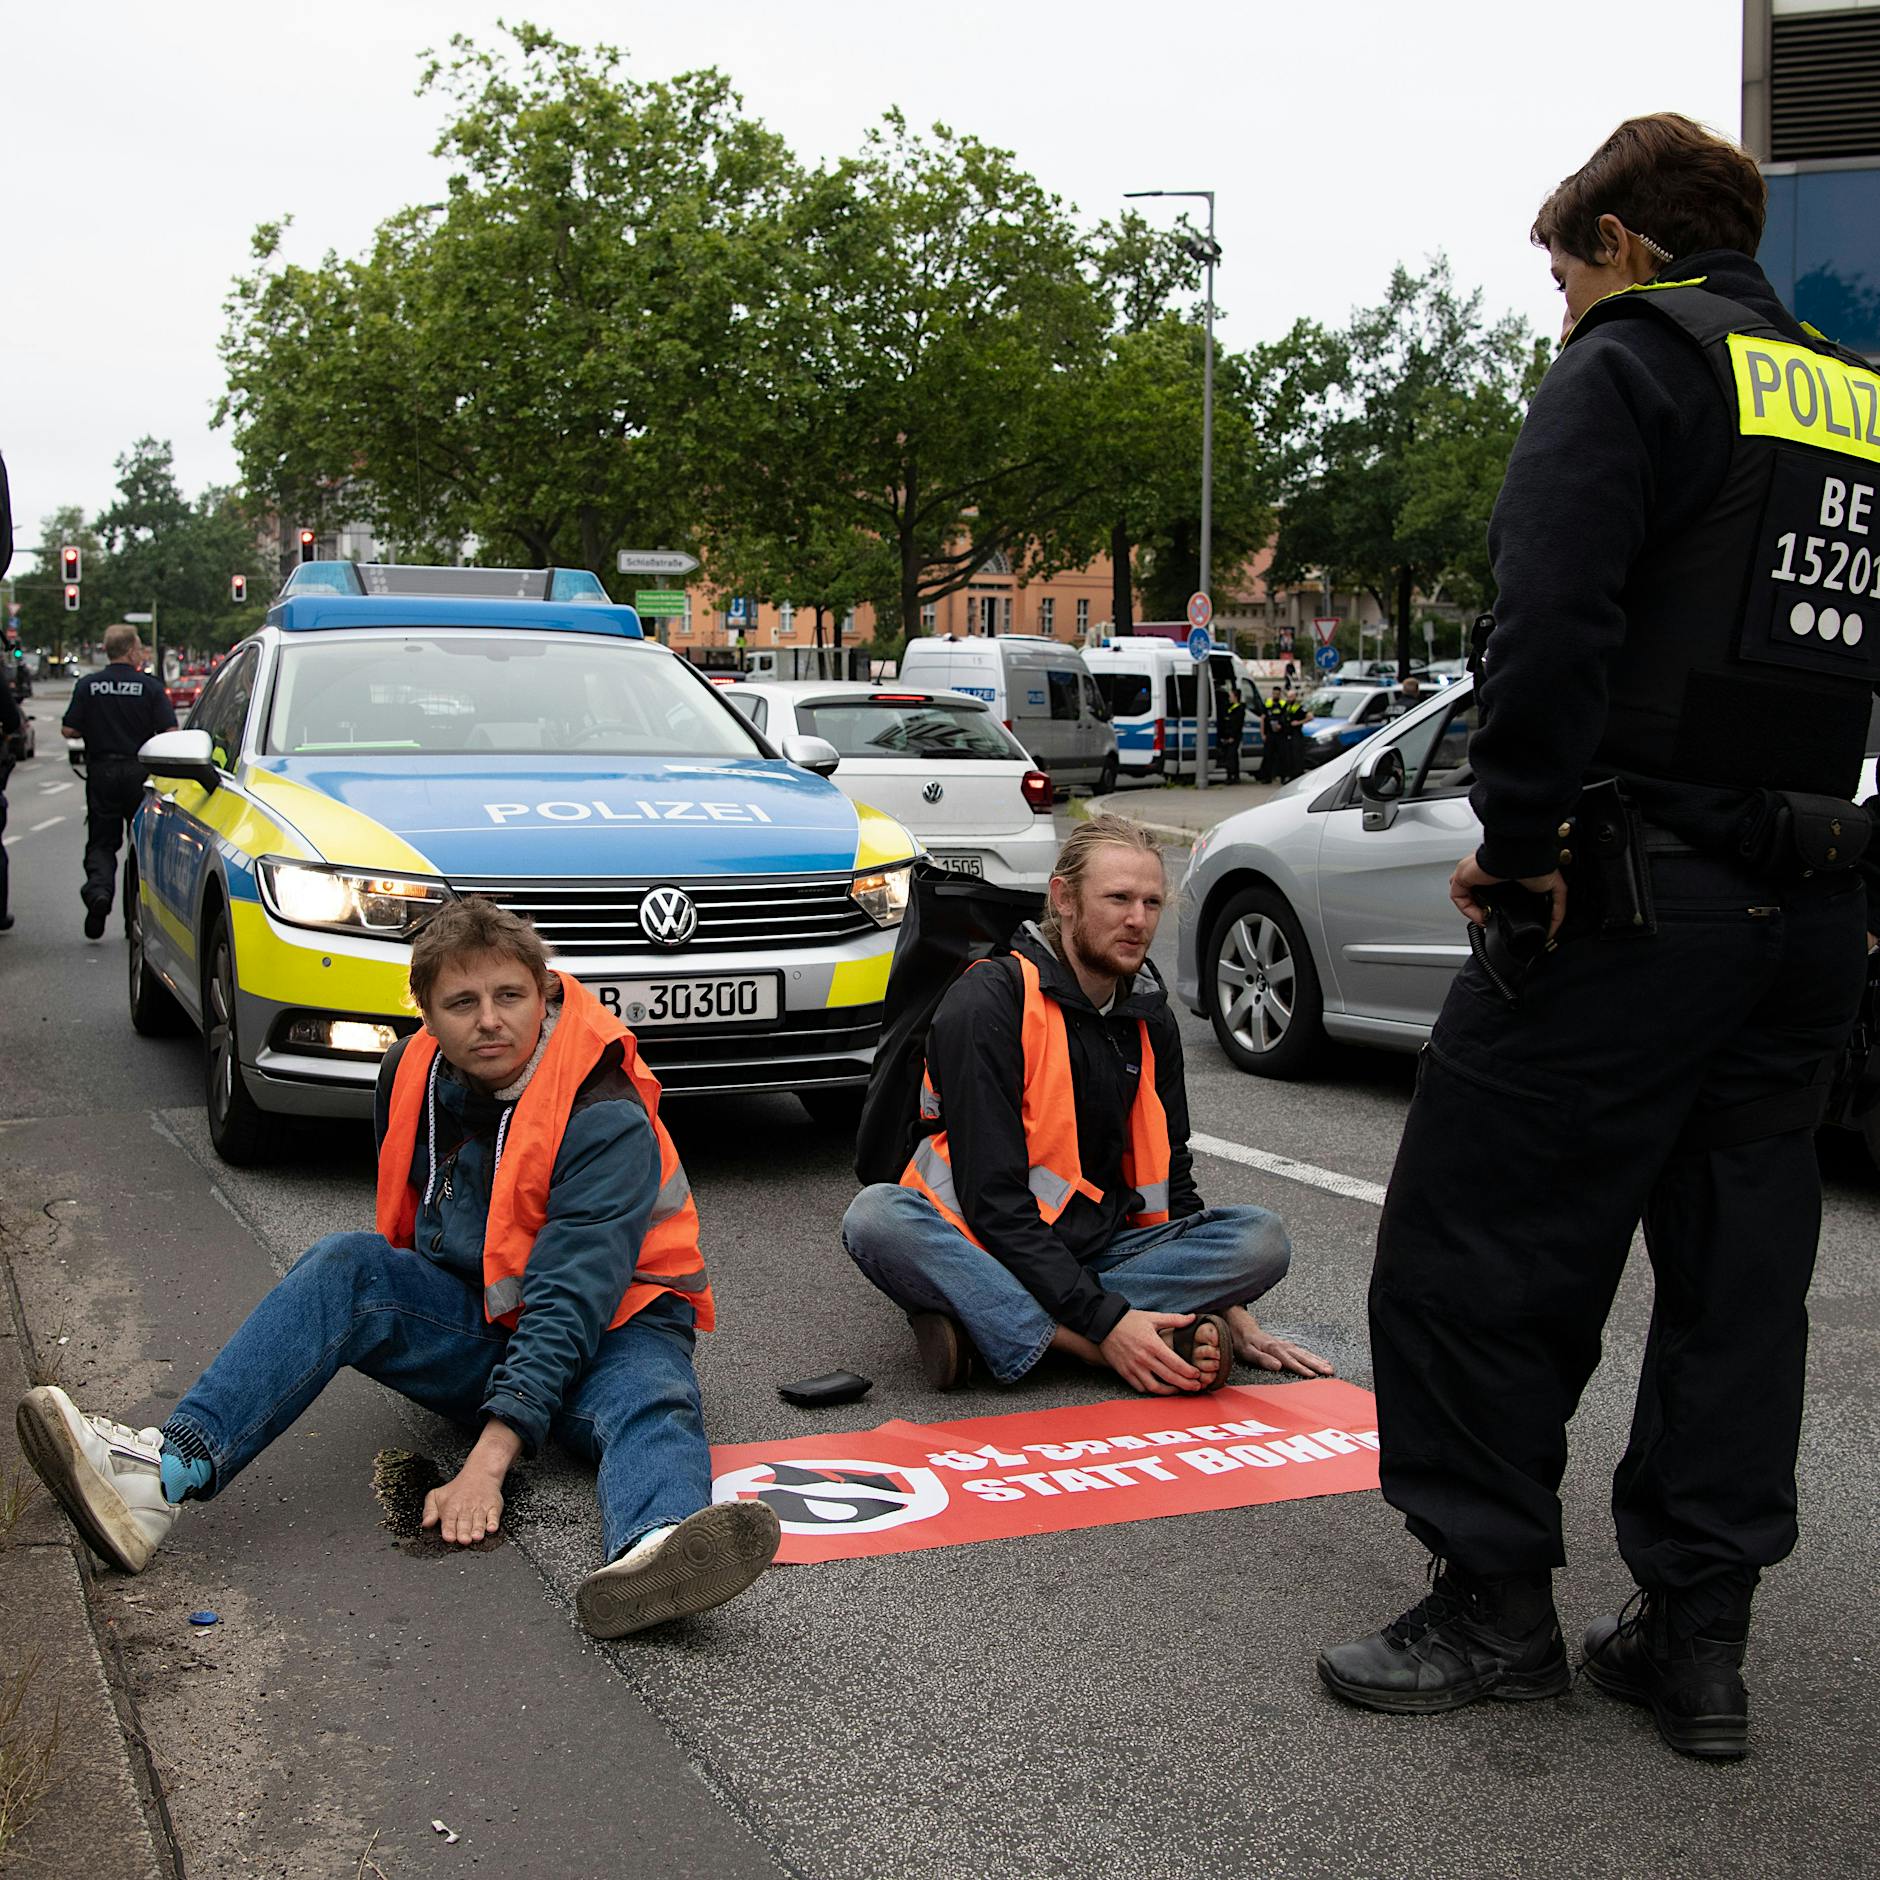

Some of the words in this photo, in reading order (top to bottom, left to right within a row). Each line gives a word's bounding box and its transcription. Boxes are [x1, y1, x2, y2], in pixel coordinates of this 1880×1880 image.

[1820, 477, 1874, 534] BE
[90, 682, 143, 696] POLIZEI
[484, 801, 772, 824] POLIZEI
[648, 980, 758, 1020] 30300
[961, 1456, 1180, 1502] STATT
